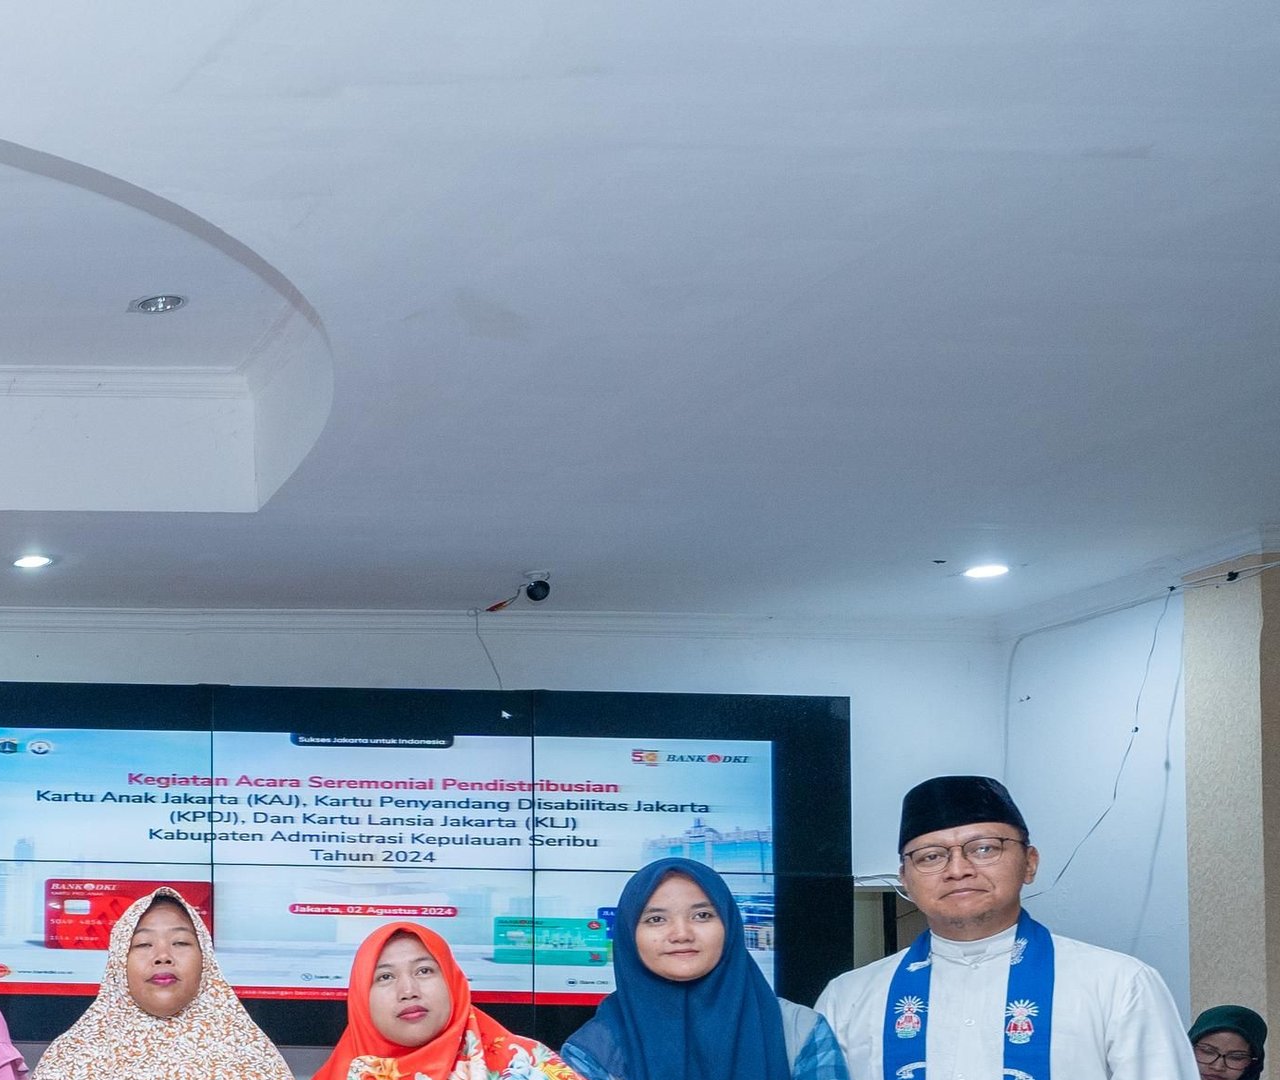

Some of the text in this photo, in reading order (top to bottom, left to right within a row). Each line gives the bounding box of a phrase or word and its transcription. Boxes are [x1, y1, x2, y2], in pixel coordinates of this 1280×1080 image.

[298, 736, 331, 744] Sukses
[667, 754, 706, 763] BANK
[722, 755, 750, 764] DKI
[128, 773, 620, 793] Kegiatan Acara Seremonial Pendistribusian
[36, 790, 709, 813] Kartu Anak Jakarta (KAJ), Kartu Penyandang Disabilitas Jakarta
[170, 811, 577, 830] (KPDJ), Dan Kartu Lansia Jakarta (KLJ)
[148, 829, 598, 847] Kabupaten Administrasi Kepulauan Seribu
[310, 849, 436, 863] Tahun 2024
[293, 904, 453, 916] Jakarta, 02 Agustus 2024
